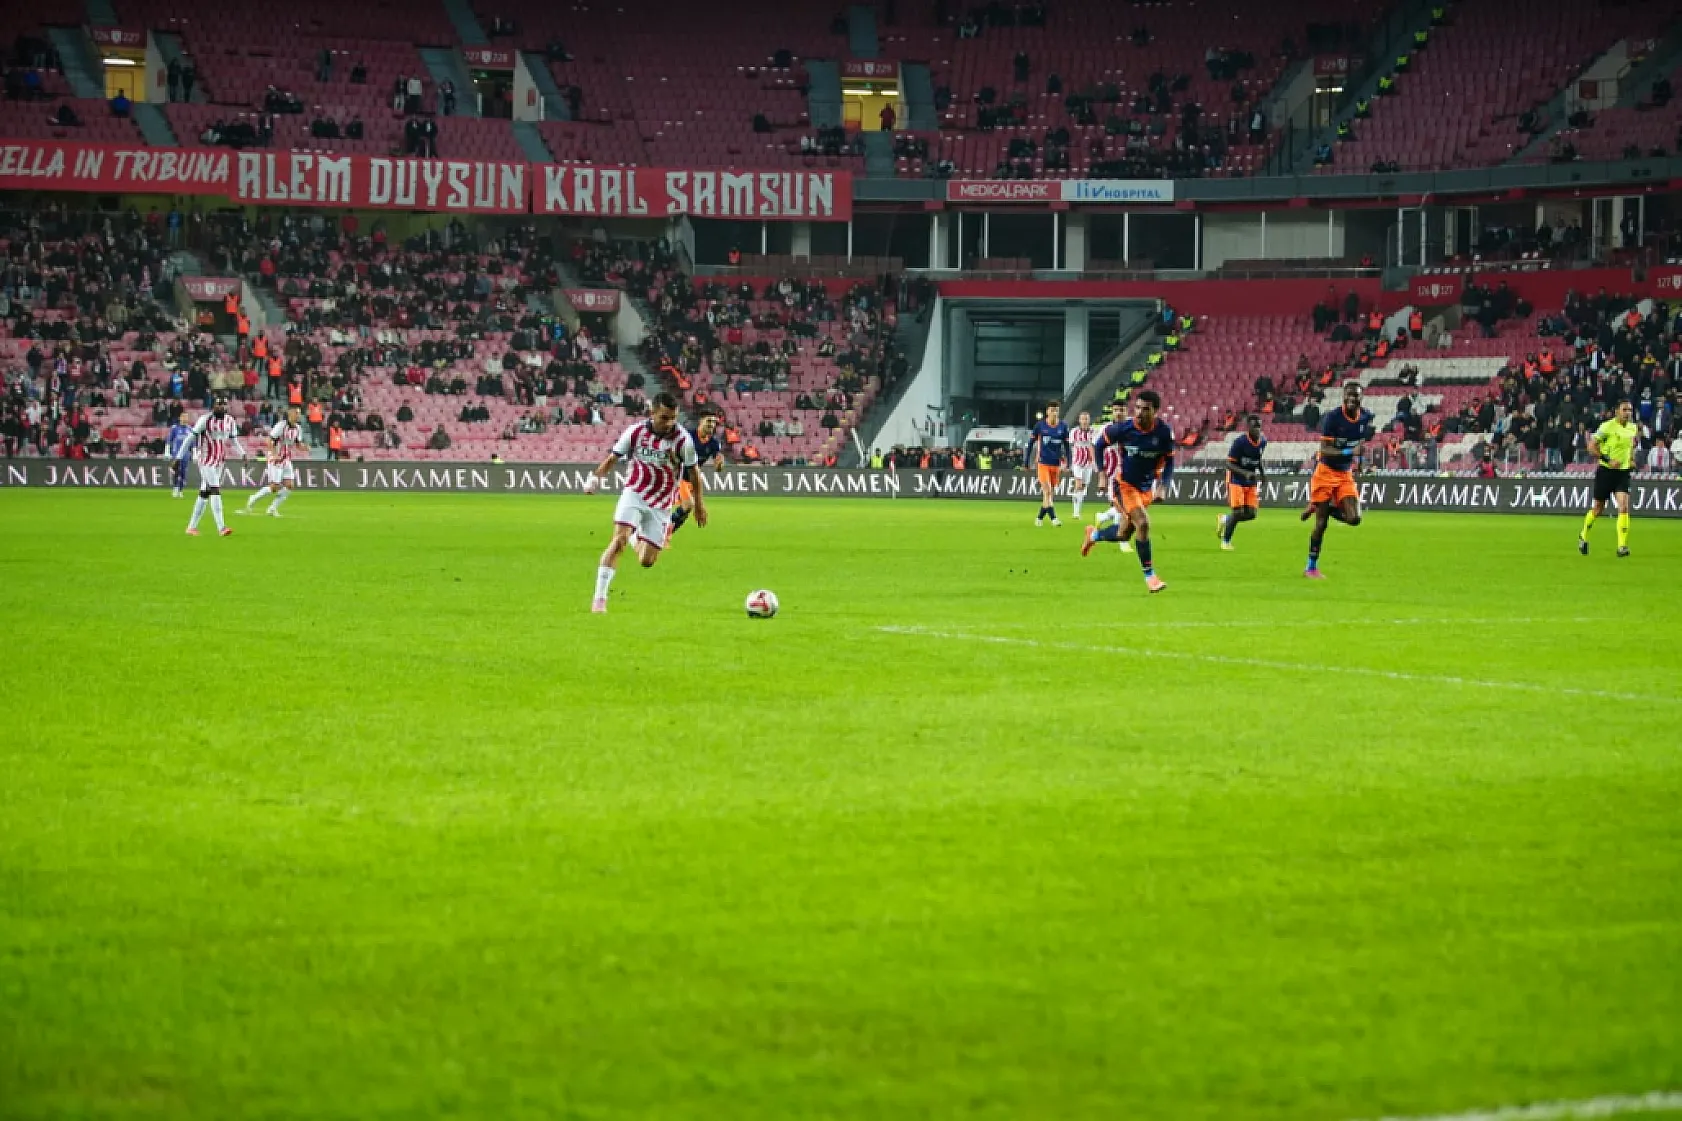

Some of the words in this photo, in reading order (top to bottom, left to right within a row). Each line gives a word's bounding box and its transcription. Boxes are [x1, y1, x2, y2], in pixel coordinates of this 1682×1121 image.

[0, 146, 65, 178] ELLA
[74, 150, 104, 180] IN
[113, 151, 229, 183] TRIBUNA
[238, 152, 351, 202] ALEM
[369, 157, 523, 209] DUYSUN
[544, 166, 648, 215] KRAL
[665, 171, 833, 216] SAMSUN
[1104, 188, 1161, 198] HOSPITAL
[357, 468, 489, 488] JAKAMEN
[700, 471, 768, 491] AMEN
[782, 473, 900, 493] JAKAMEN
[913, 473, 1001, 495] JAKAMEN
[1395, 483, 1500, 506] JAKAMEN
[1633, 486, 1682, 510] JAK
